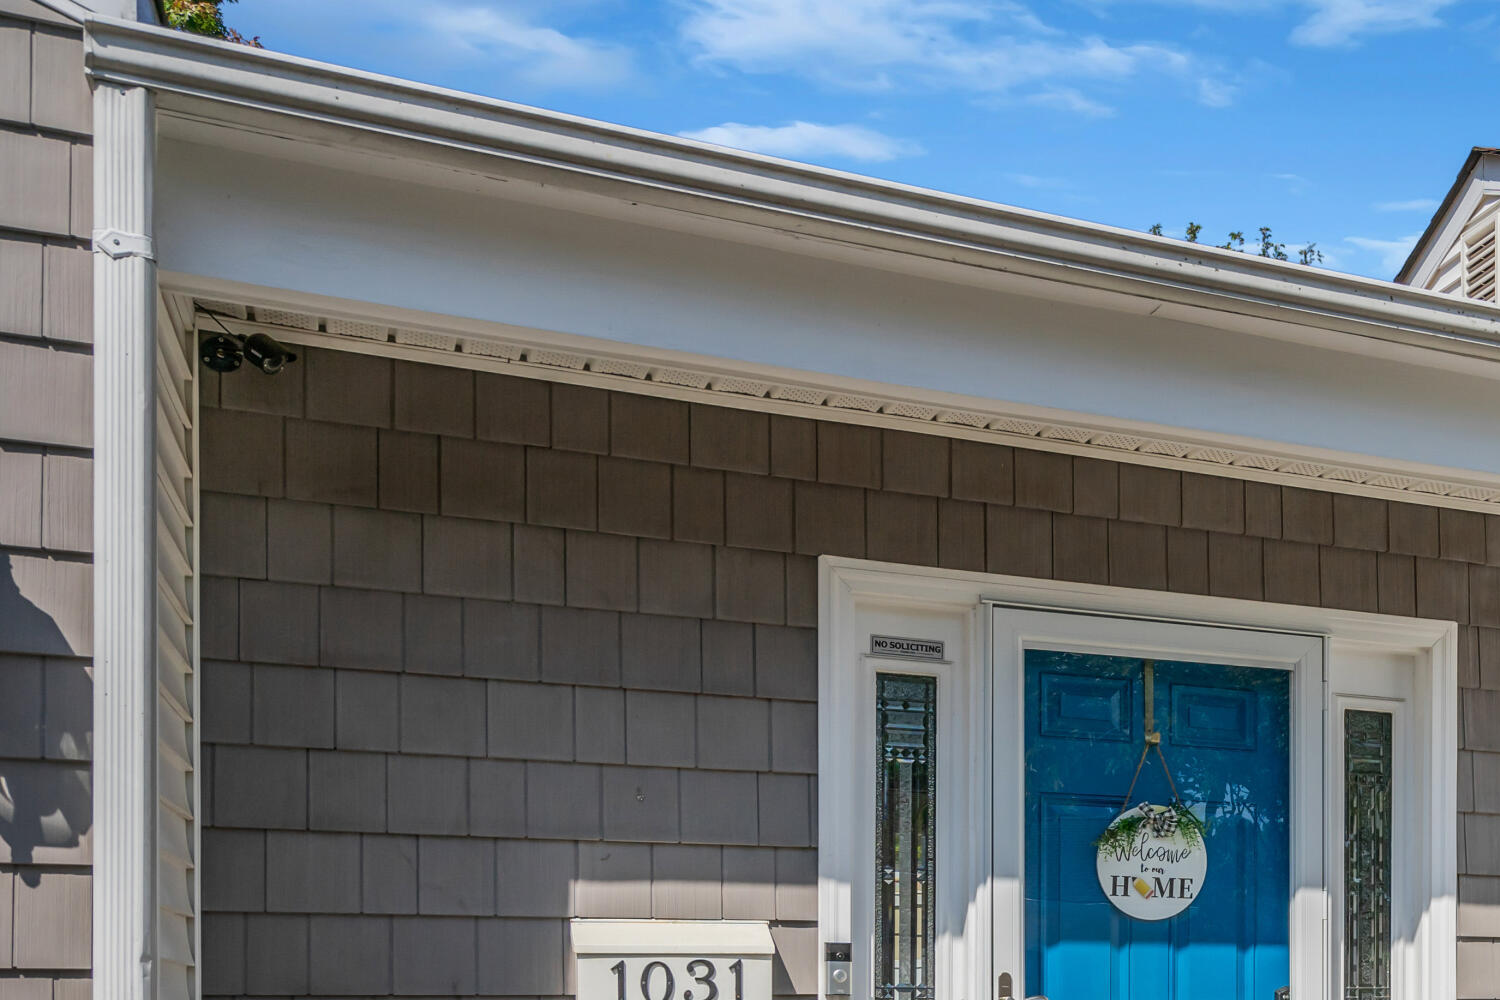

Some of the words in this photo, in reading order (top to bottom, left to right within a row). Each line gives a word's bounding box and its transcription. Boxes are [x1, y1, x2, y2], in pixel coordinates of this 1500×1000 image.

[874, 640, 888, 648] NO
[889, 641, 941, 653] SOLICITING
[1114, 832, 1192, 864] Welcome
[1140, 863, 1149, 873] to
[1151, 867, 1164, 875] our
[1109, 875, 1193, 899] HME
